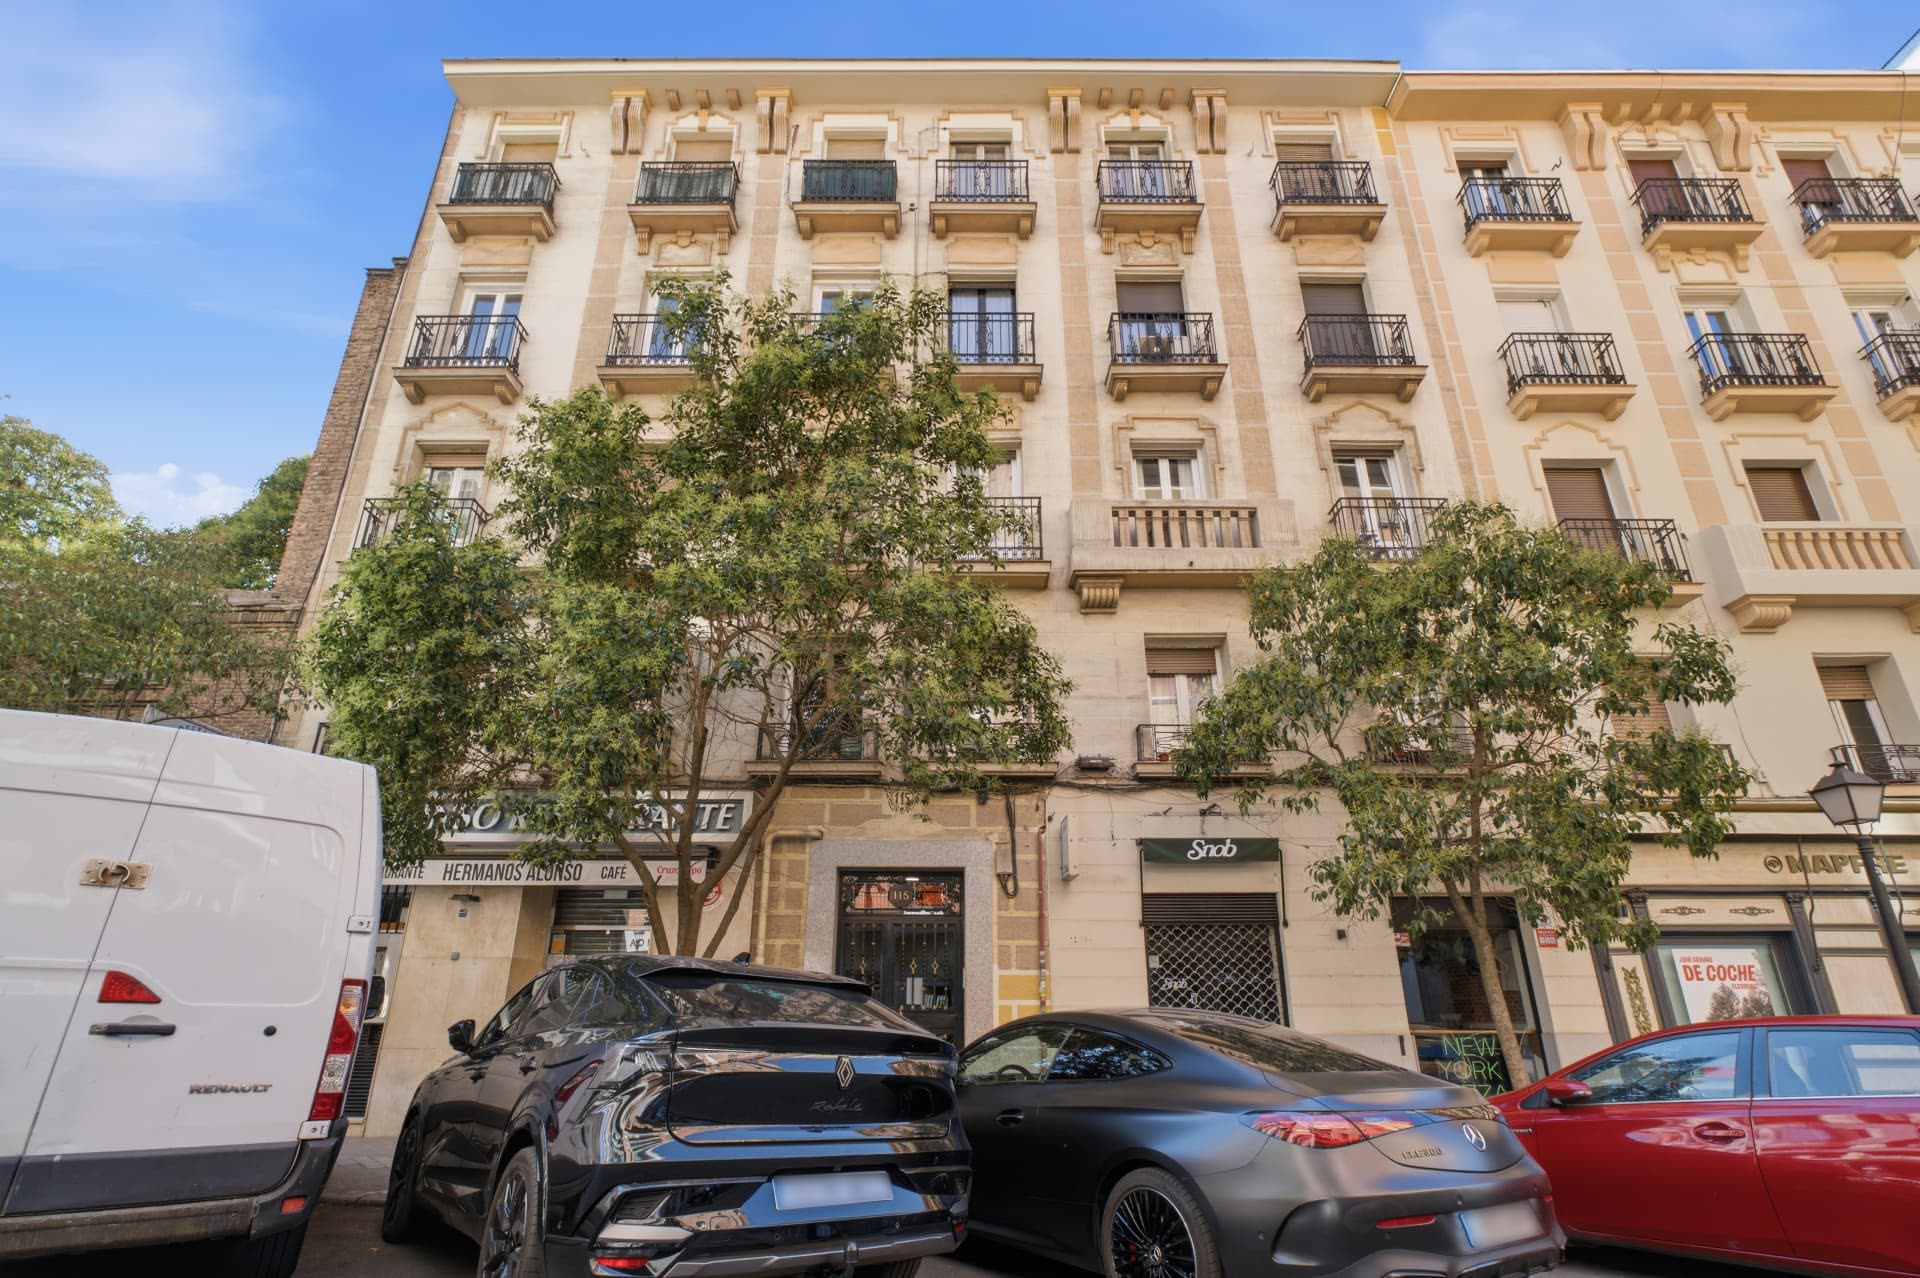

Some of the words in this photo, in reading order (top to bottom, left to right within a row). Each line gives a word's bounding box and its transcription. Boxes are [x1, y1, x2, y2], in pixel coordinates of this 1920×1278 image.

[894, 791, 911, 805] 115
[1187, 839, 1238, 861] Snob
[443, 863, 522, 881] HERMANOS
[525, 863, 583, 881] ALONSO
[601, 864, 627, 880] CAFÉ
[894, 890, 910, 900] 115
[1682, 964, 1704, 982] DE
[1706, 964, 1756, 982] COCHE
[1442, 1033, 1496, 1057] NEW
[1438, 1060, 1503, 1081] YORK
[189, 1083, 272, 1095] RENAULT
